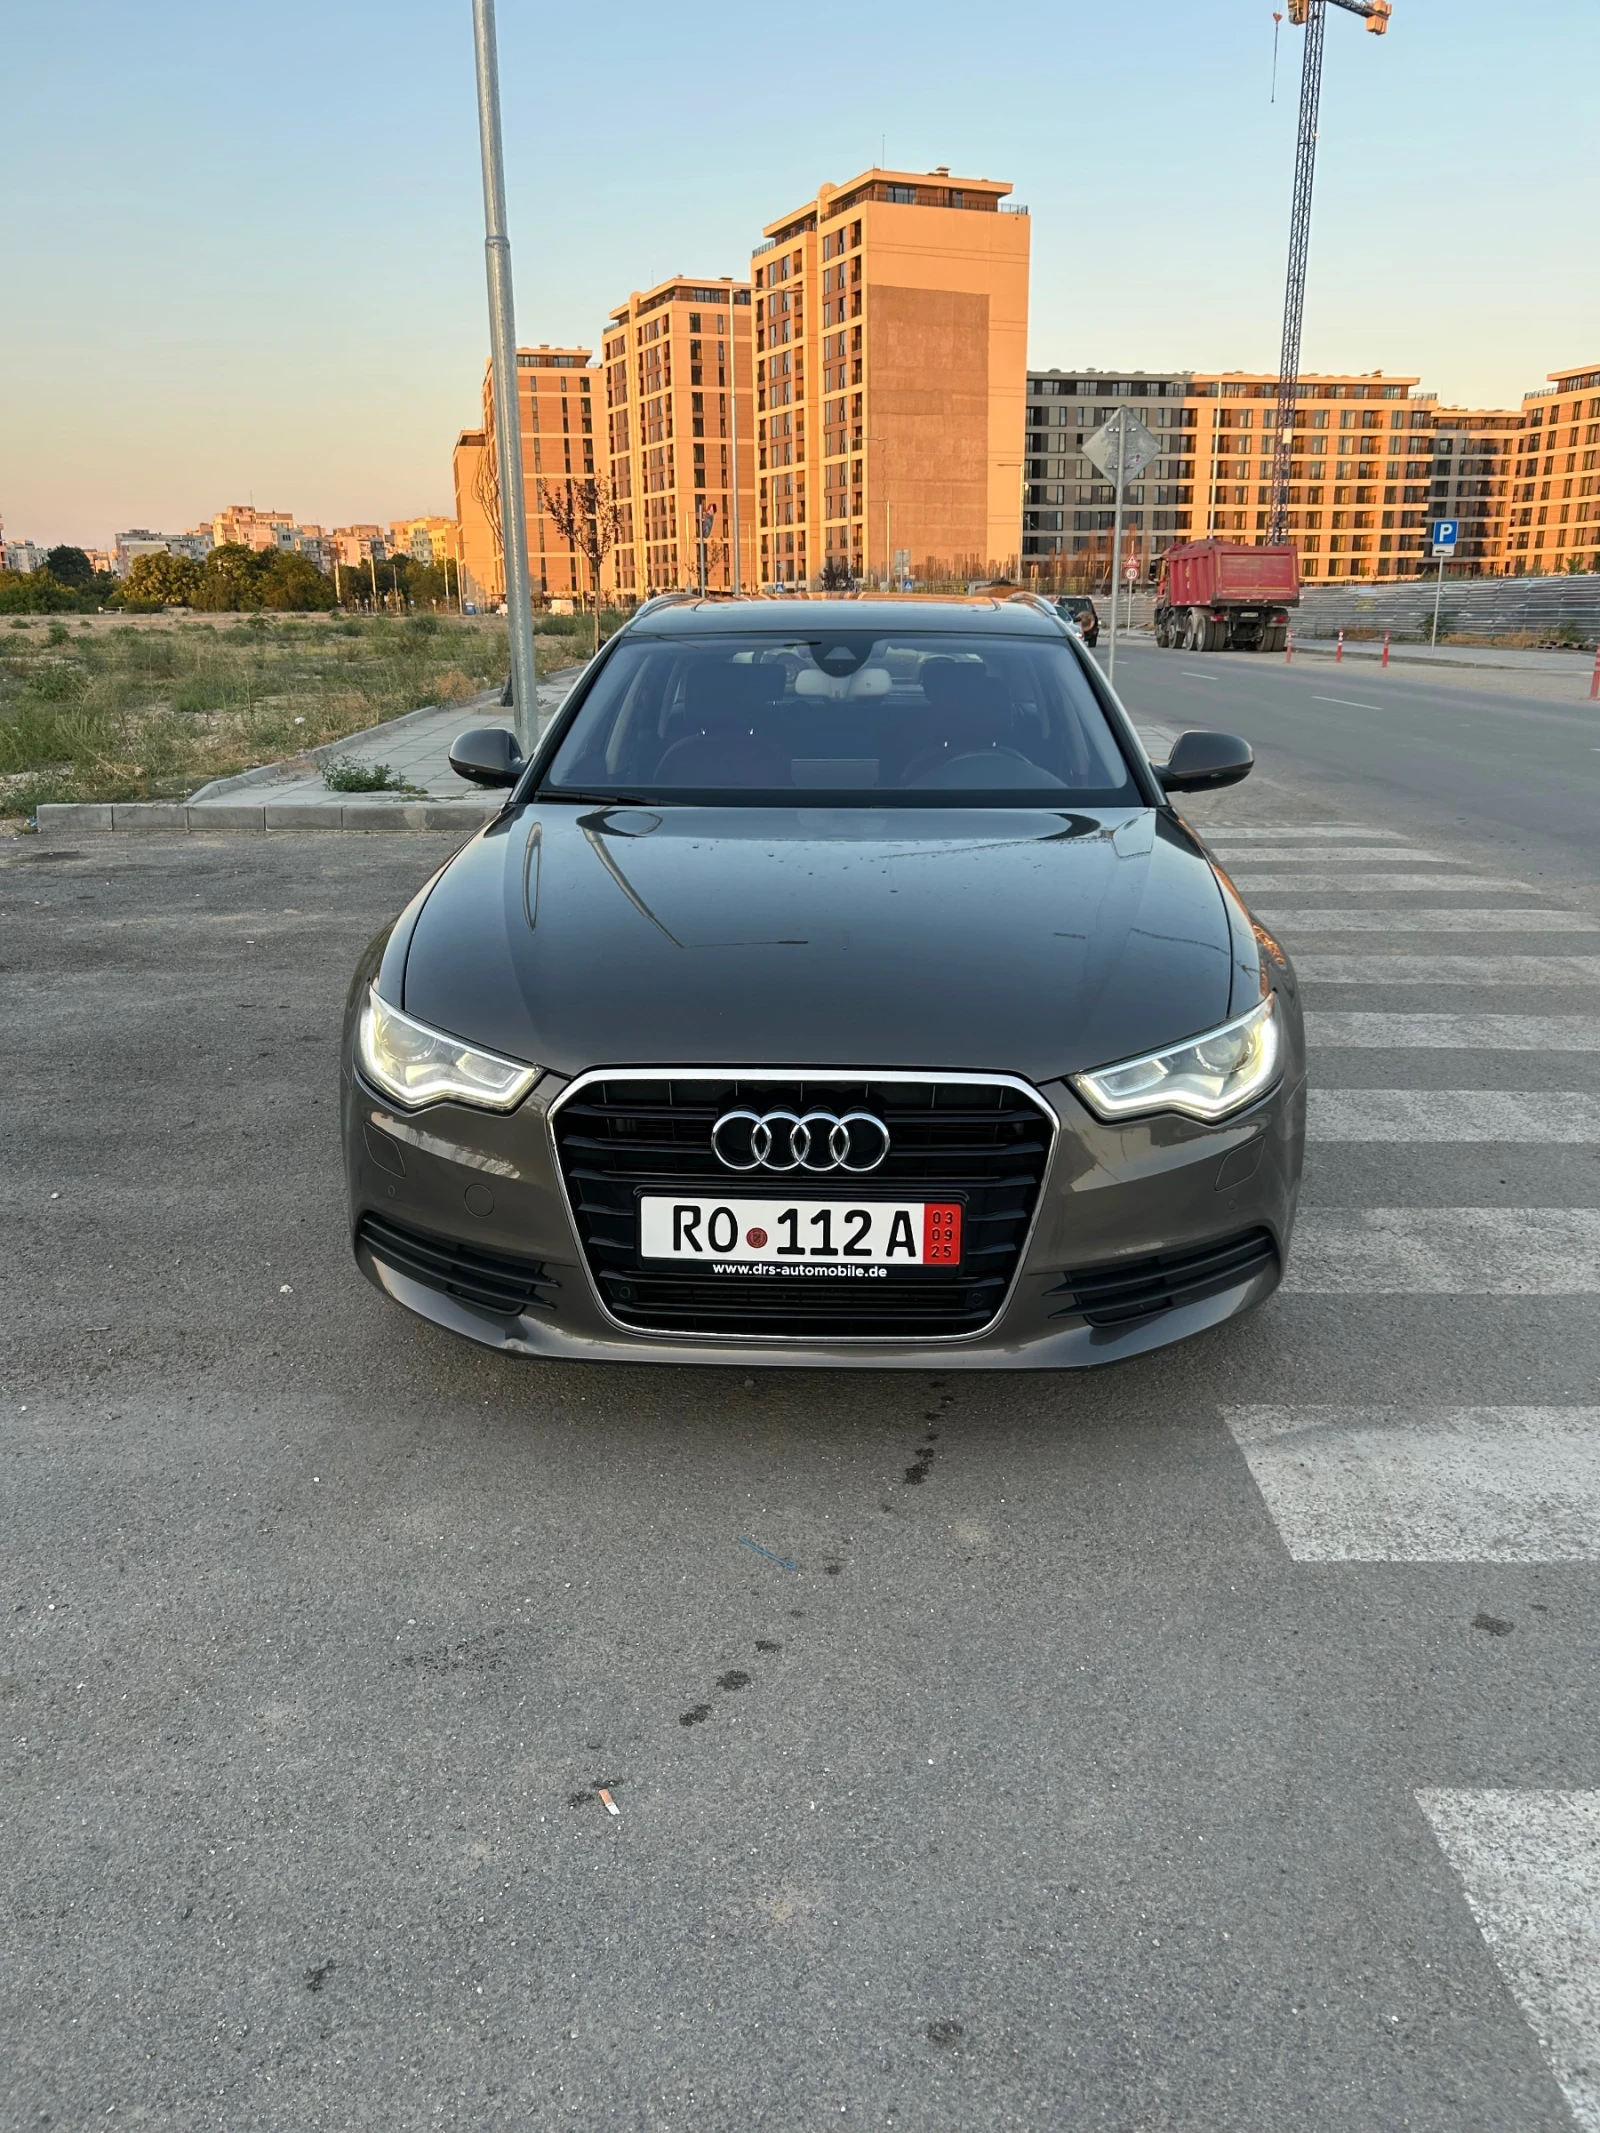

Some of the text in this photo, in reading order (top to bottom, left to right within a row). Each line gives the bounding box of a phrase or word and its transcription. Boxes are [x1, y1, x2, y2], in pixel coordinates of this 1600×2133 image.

[1439, 523, 1453, 541] P
[1127, 570, 1136, 578] 30
[932, 1210, 954, 1225] 03
[672, 1204, 739, 1253] RO
[776, 1208, 873, 1257] 112
[885, 1210, 917, 1258] A
[931, 1227, 953, 1241] 09
[930, 1244, 952, 1258] 25
[712, 1263, 888, 1278] www.drs-automobile.de
